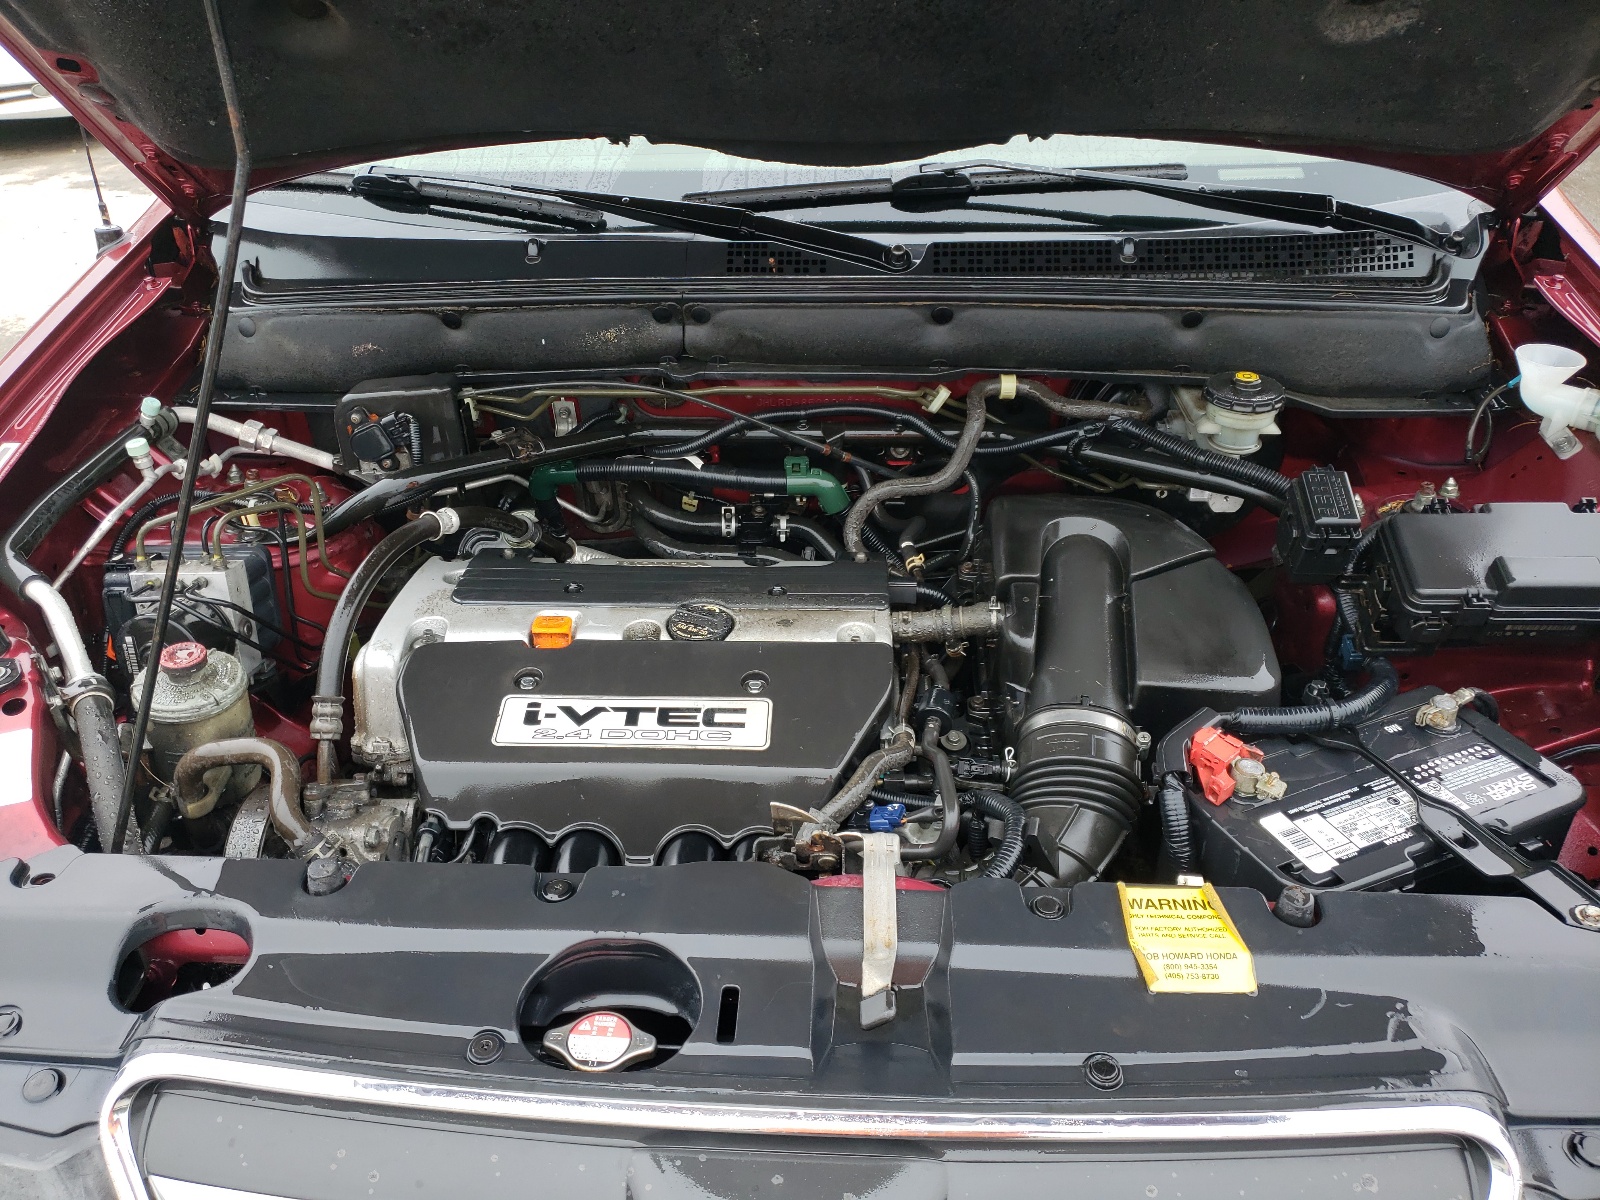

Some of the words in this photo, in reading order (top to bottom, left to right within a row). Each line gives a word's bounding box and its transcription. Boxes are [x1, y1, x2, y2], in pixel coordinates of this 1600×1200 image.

[523, 702, 747, 728] i-VTEC
[532, 728, 592, 740] 2.4
[600, 728, 733, 741] DOHC
[1489, 784, 1538, 801] SUPER
[1384, 831, 1414, 846] POISON
[1161, 952, 1204, 960] HOWARD
[1205, 952, 1238, 960] HONDA
